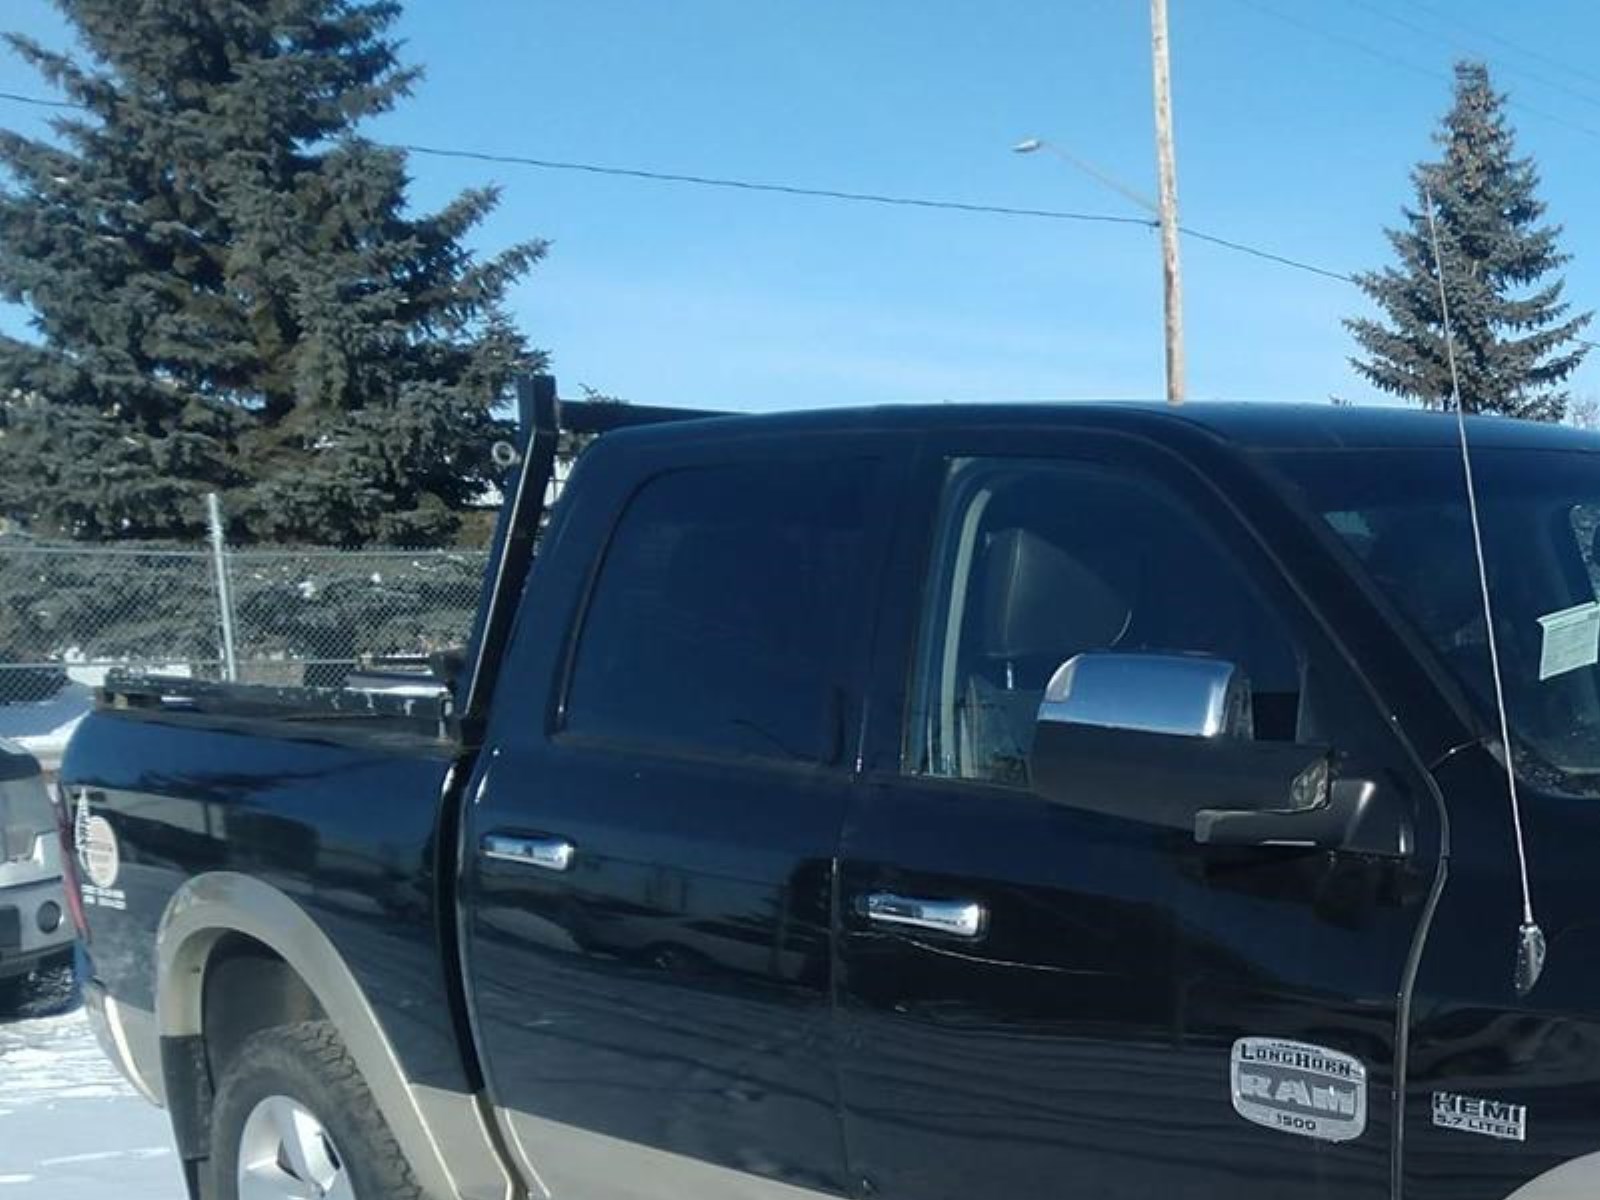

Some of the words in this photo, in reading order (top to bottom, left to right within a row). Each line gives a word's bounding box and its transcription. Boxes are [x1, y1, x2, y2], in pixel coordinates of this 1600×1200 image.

[1240, 1043, 1351, 1076] LONGHORN
[1240, 1074, 1355, 1115] RAM
[1433, 1092, 1522, 1124] HEMI
[1276, 1112, 1317, 1131] 1500
[1436, 1113, 1463, 1127] 5.7
[1468, 1119, 1518, 1137] LITER
